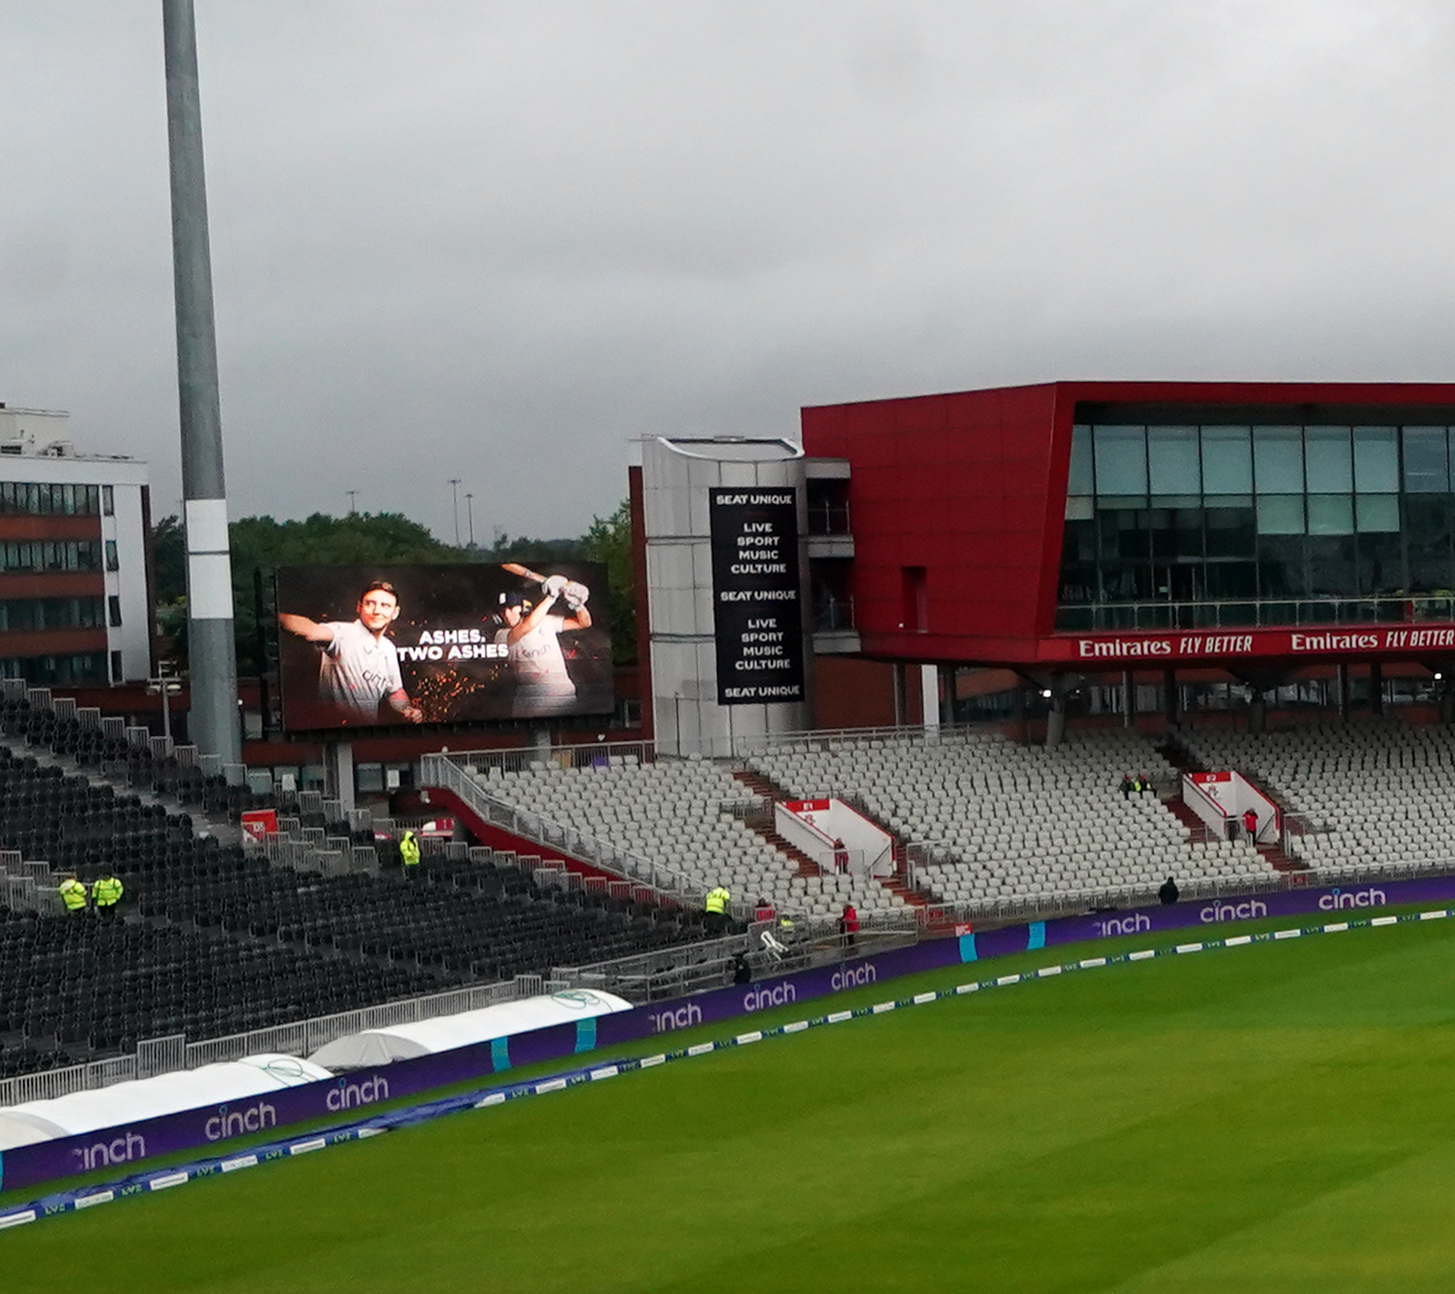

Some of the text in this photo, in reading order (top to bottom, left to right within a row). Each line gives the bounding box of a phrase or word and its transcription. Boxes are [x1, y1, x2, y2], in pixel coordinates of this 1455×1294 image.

[717, 495, 792, 505] SEAT UNIQUE
[744, 523, 773, 533] LIVE
[737, 537, 780, 547] SPORT
[739, 550, 779, 560] MUSIC
[731, 564, 786, 574] CULTURE
[721, 590, 796, 601] SEAT UNIQUE
[748, 619, 777, 628] LIVE
[419, 629, 486, 645] ASHES.
[742, 632, 784, 643] SPORT
[1291, 629, 1454, 651] Emirates FLY BETTER
[397, 647, 442, 661] TWO
[449, 644, 509, 658] ASHES
[743, 646, 783, 656] MUSIC
[1079, 634, 1253, 659] Emirates FLY BETTER
[735, 660, 791, 670] CULTURE
[725, 686, 800, 698] SEAT UNIQUE
[1319, 888, 1386, 911] cinch
[1200, 899, 1267, 923] cinch
[831, 964, 876, 992] cinch
[743, 983, 796, 1012] cinch
[326, 1075, 389, 1112] cinch
[205, 1102, 276, 1142] cinch
